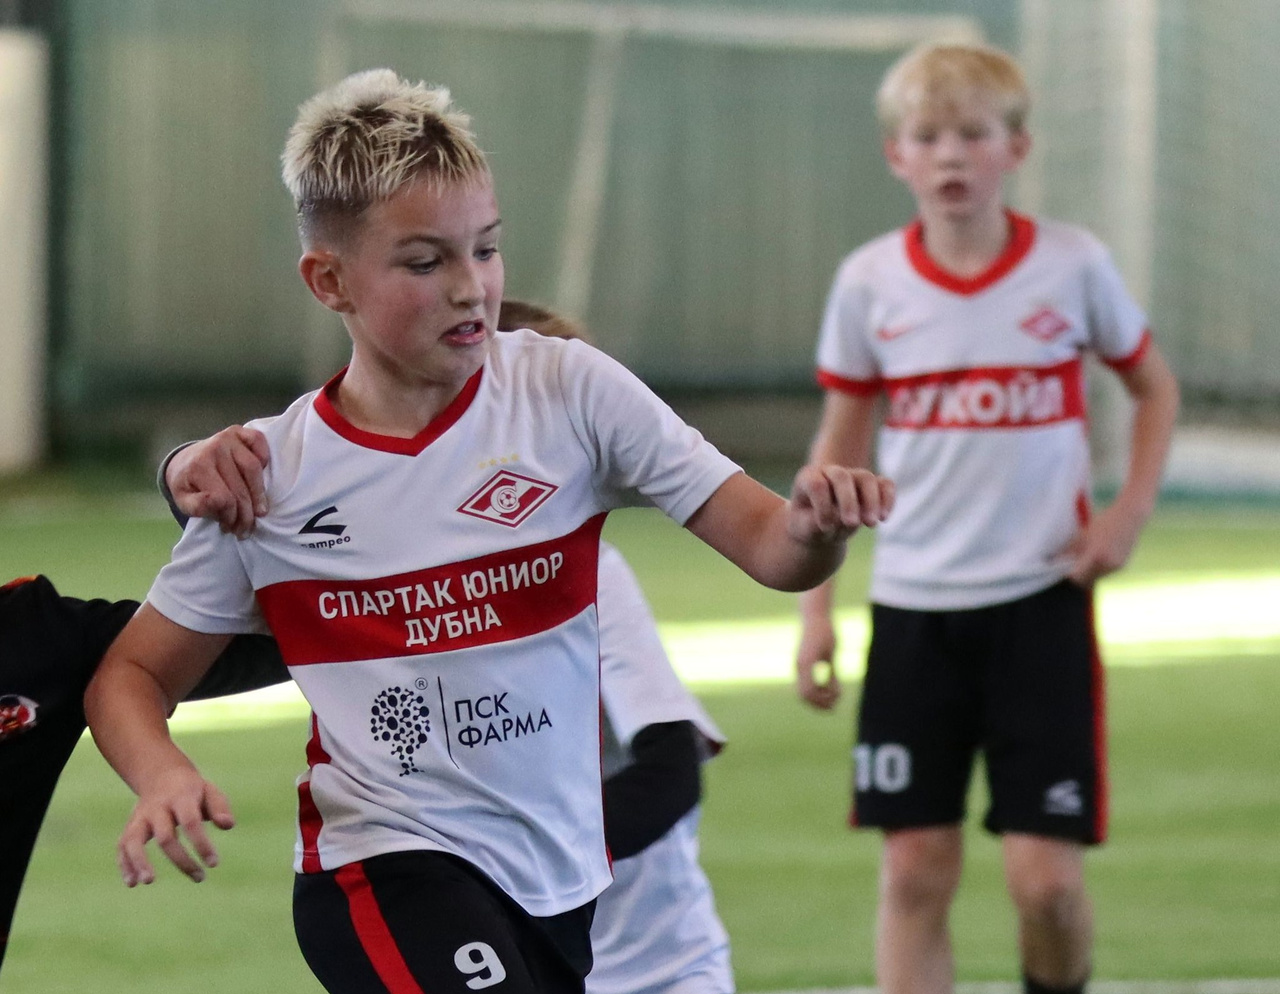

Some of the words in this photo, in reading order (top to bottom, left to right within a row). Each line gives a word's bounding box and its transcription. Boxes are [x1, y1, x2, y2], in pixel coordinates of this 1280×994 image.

[318, 578, 456, 620] СПАРТАК
[461, 551, 564, 601] ЮНИОР
[405, 603, 503, 648] ДУБНА
[454, 691, 510, 723] ПСК
[457, 707, 553, 748] ФАРМА
[852, 743, 911, 793] 10
[453, 941, 507, 990] 9
